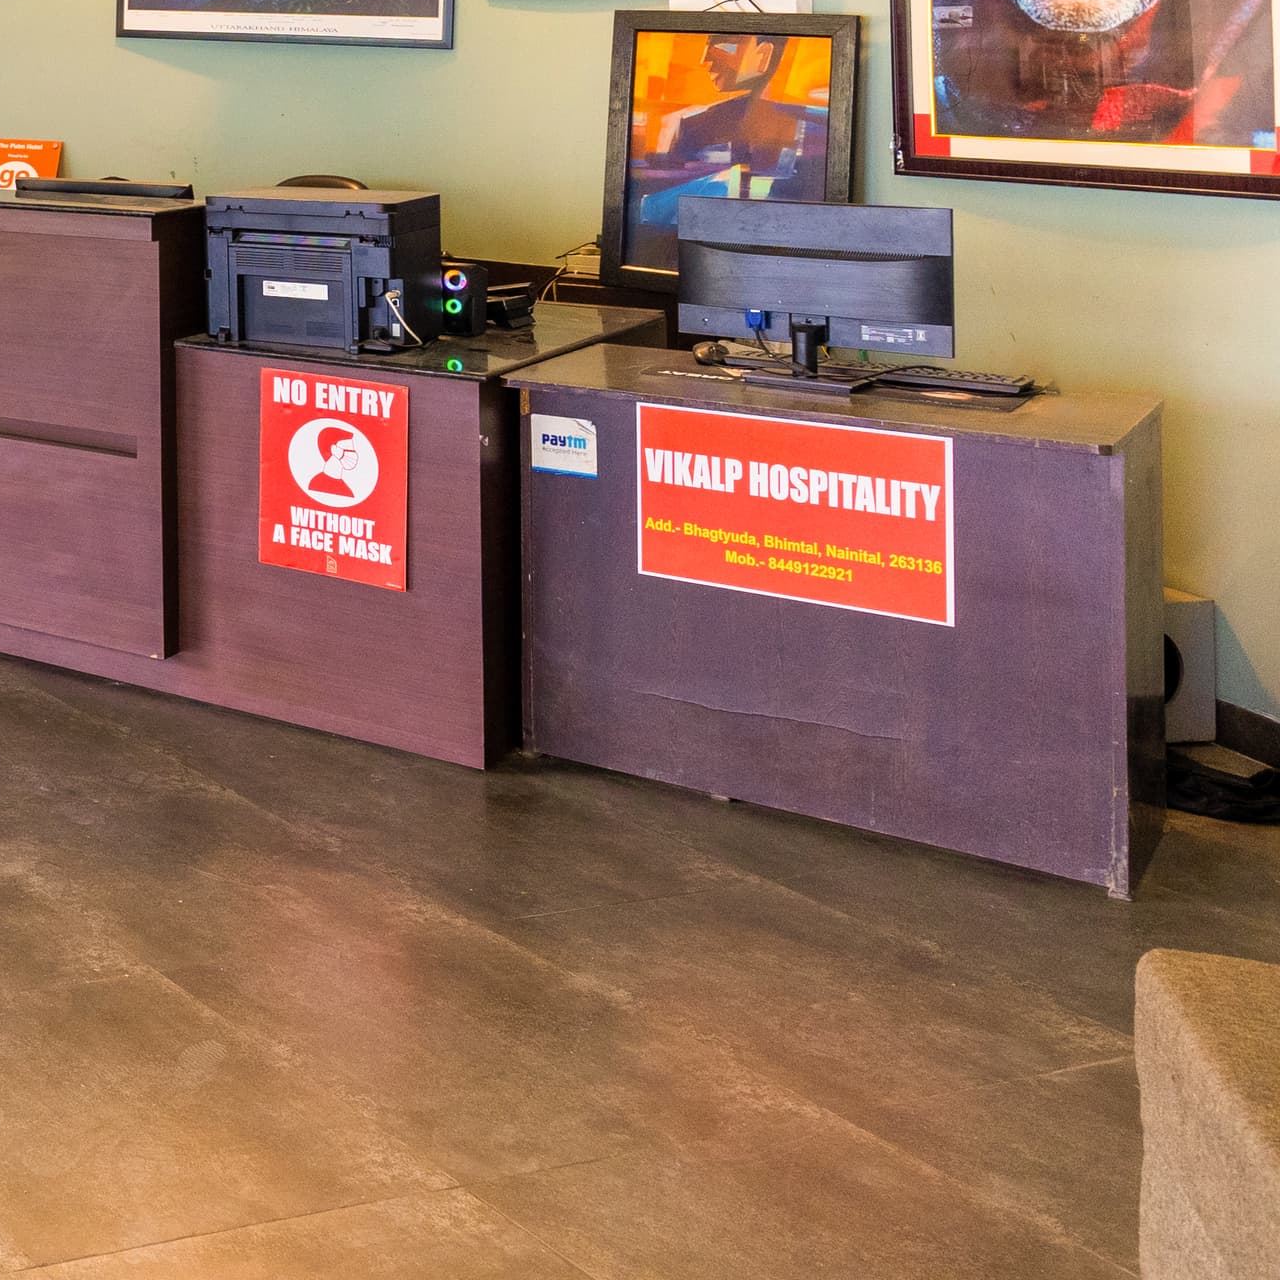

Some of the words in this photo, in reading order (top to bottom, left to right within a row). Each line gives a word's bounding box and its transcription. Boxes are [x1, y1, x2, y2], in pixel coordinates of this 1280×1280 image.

[273, 376, 307, 406] NO
[315, 382, 395, 418] ENTRY
[644, 447, 743, 493] VIKALP
[749, 460, 941, 521] HOSPITALITY
[272, 523, 285, 544] A
[290, 527, 333, 553] FACE
[338, 535, 393, 565] MASK
[290, 506, 375, 540] WITHOUT
[683, 522, 760, 548] Bhagtyuda,
[763, 534, 822, 558] Bhimtal,
[825, 544, 885, 568] Nainital,
[888, 554, 943, 575] 263136
[768, 557, 853, 582] 8449122921
